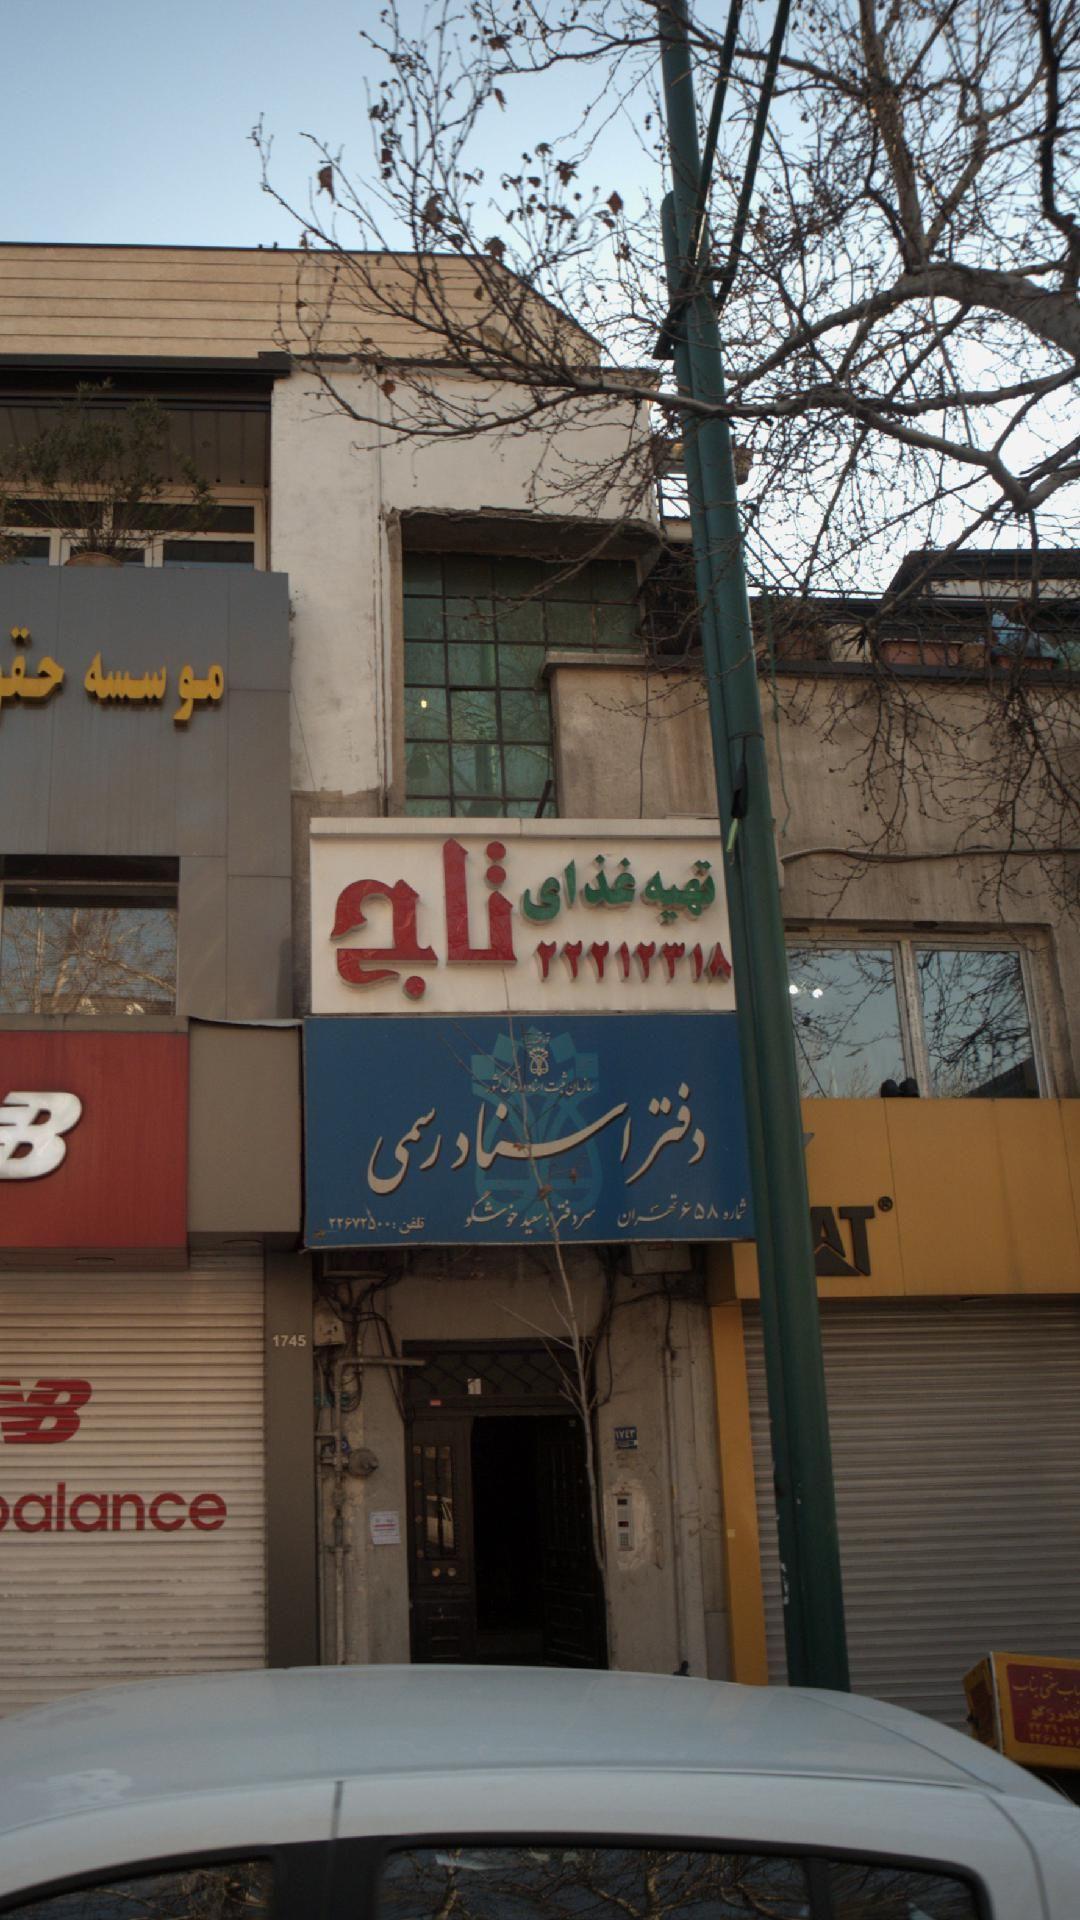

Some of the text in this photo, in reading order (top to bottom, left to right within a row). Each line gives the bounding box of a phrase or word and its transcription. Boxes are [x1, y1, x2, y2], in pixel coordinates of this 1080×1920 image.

[0, 625, 65, 711] حق
[522, 855, 717, 923] تهیه غذای
[536, 941, 732, 979] ۲۲۲۱۲۳۱۸
[367, 1083, 705, 1195] دفتر اسناد رسمی
[520, 1212, 544, 1235] سعید
[617, 1194, 748, 1228] شماره ۶۵۸ تهران
[272, 1333, 307, 1348] 1745
